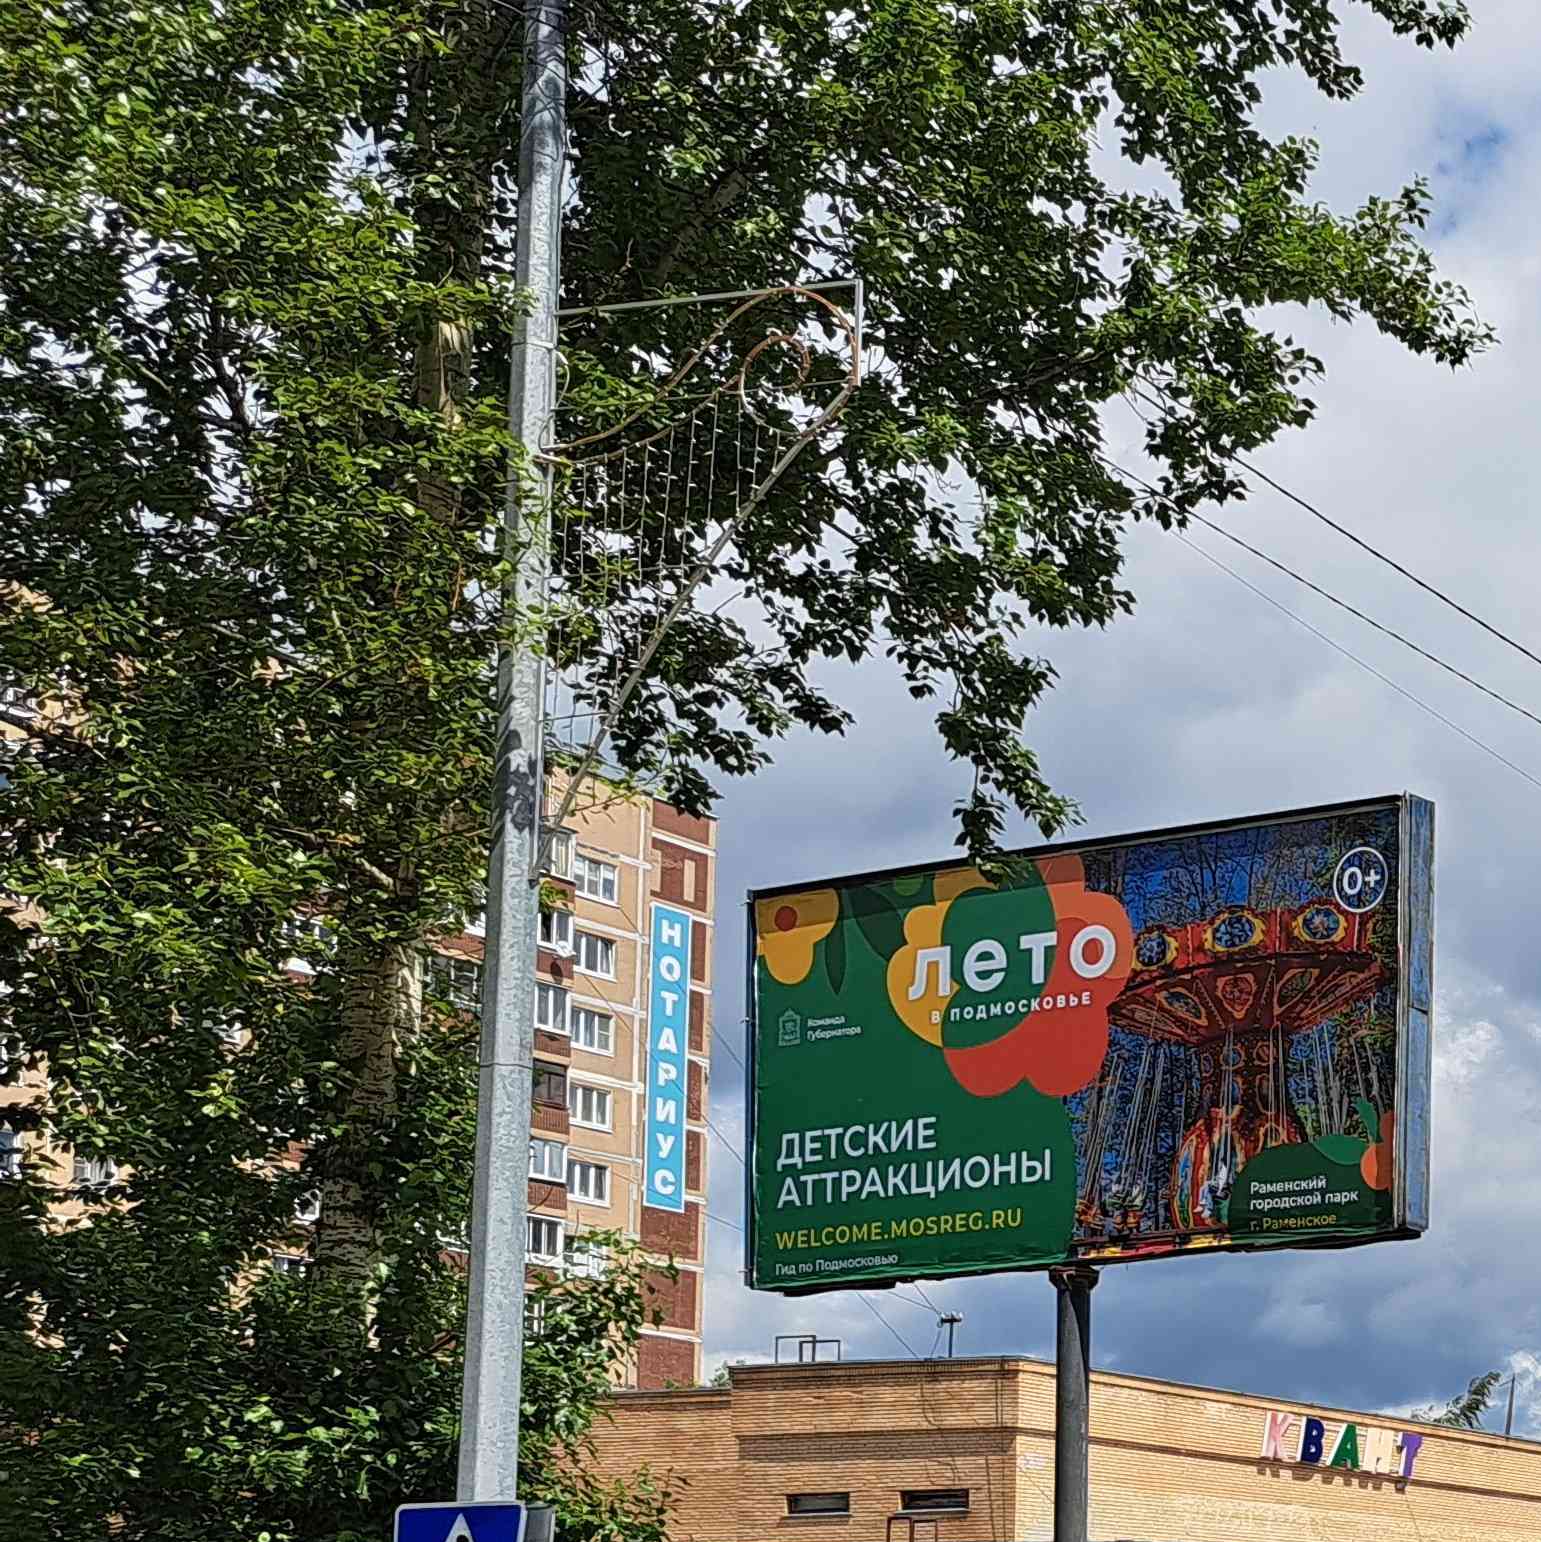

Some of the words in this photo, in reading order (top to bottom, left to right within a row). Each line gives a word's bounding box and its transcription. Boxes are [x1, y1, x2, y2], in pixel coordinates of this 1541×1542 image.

[1343, 866, 1381, 895] 0+
[908, 923, 1117, 1001] лето
[949, 991, 1092, 1022] ПОДМОСКОВЬЕ
[806, 1025, 862, 1041] Губернатора
[653, 918, 682, 1195] НОТАРИУС
[776, 1116, 937, 1171] ДЕТСКИЕ
[776, 1148, 1052, 1209] АТТРАКЦИОНЫ
[1250, 1175, 1327, 1193] Раменский
[1250, 1192, 1321, 1211] городской
[1326, 1191, 1359, 1205] парк
[775, 1208, 1023, 1250] WELCOME.MOSREG.RU
[1263, 1214, 1337, 1229] Раменское
[775, 1263, 797, 1276] Гид
[799, 1264, 813, 1275] по
[815, 1253, 899, 1273] Подмосковью
[1260, 1409, 1424, 1479] КВАНТ
